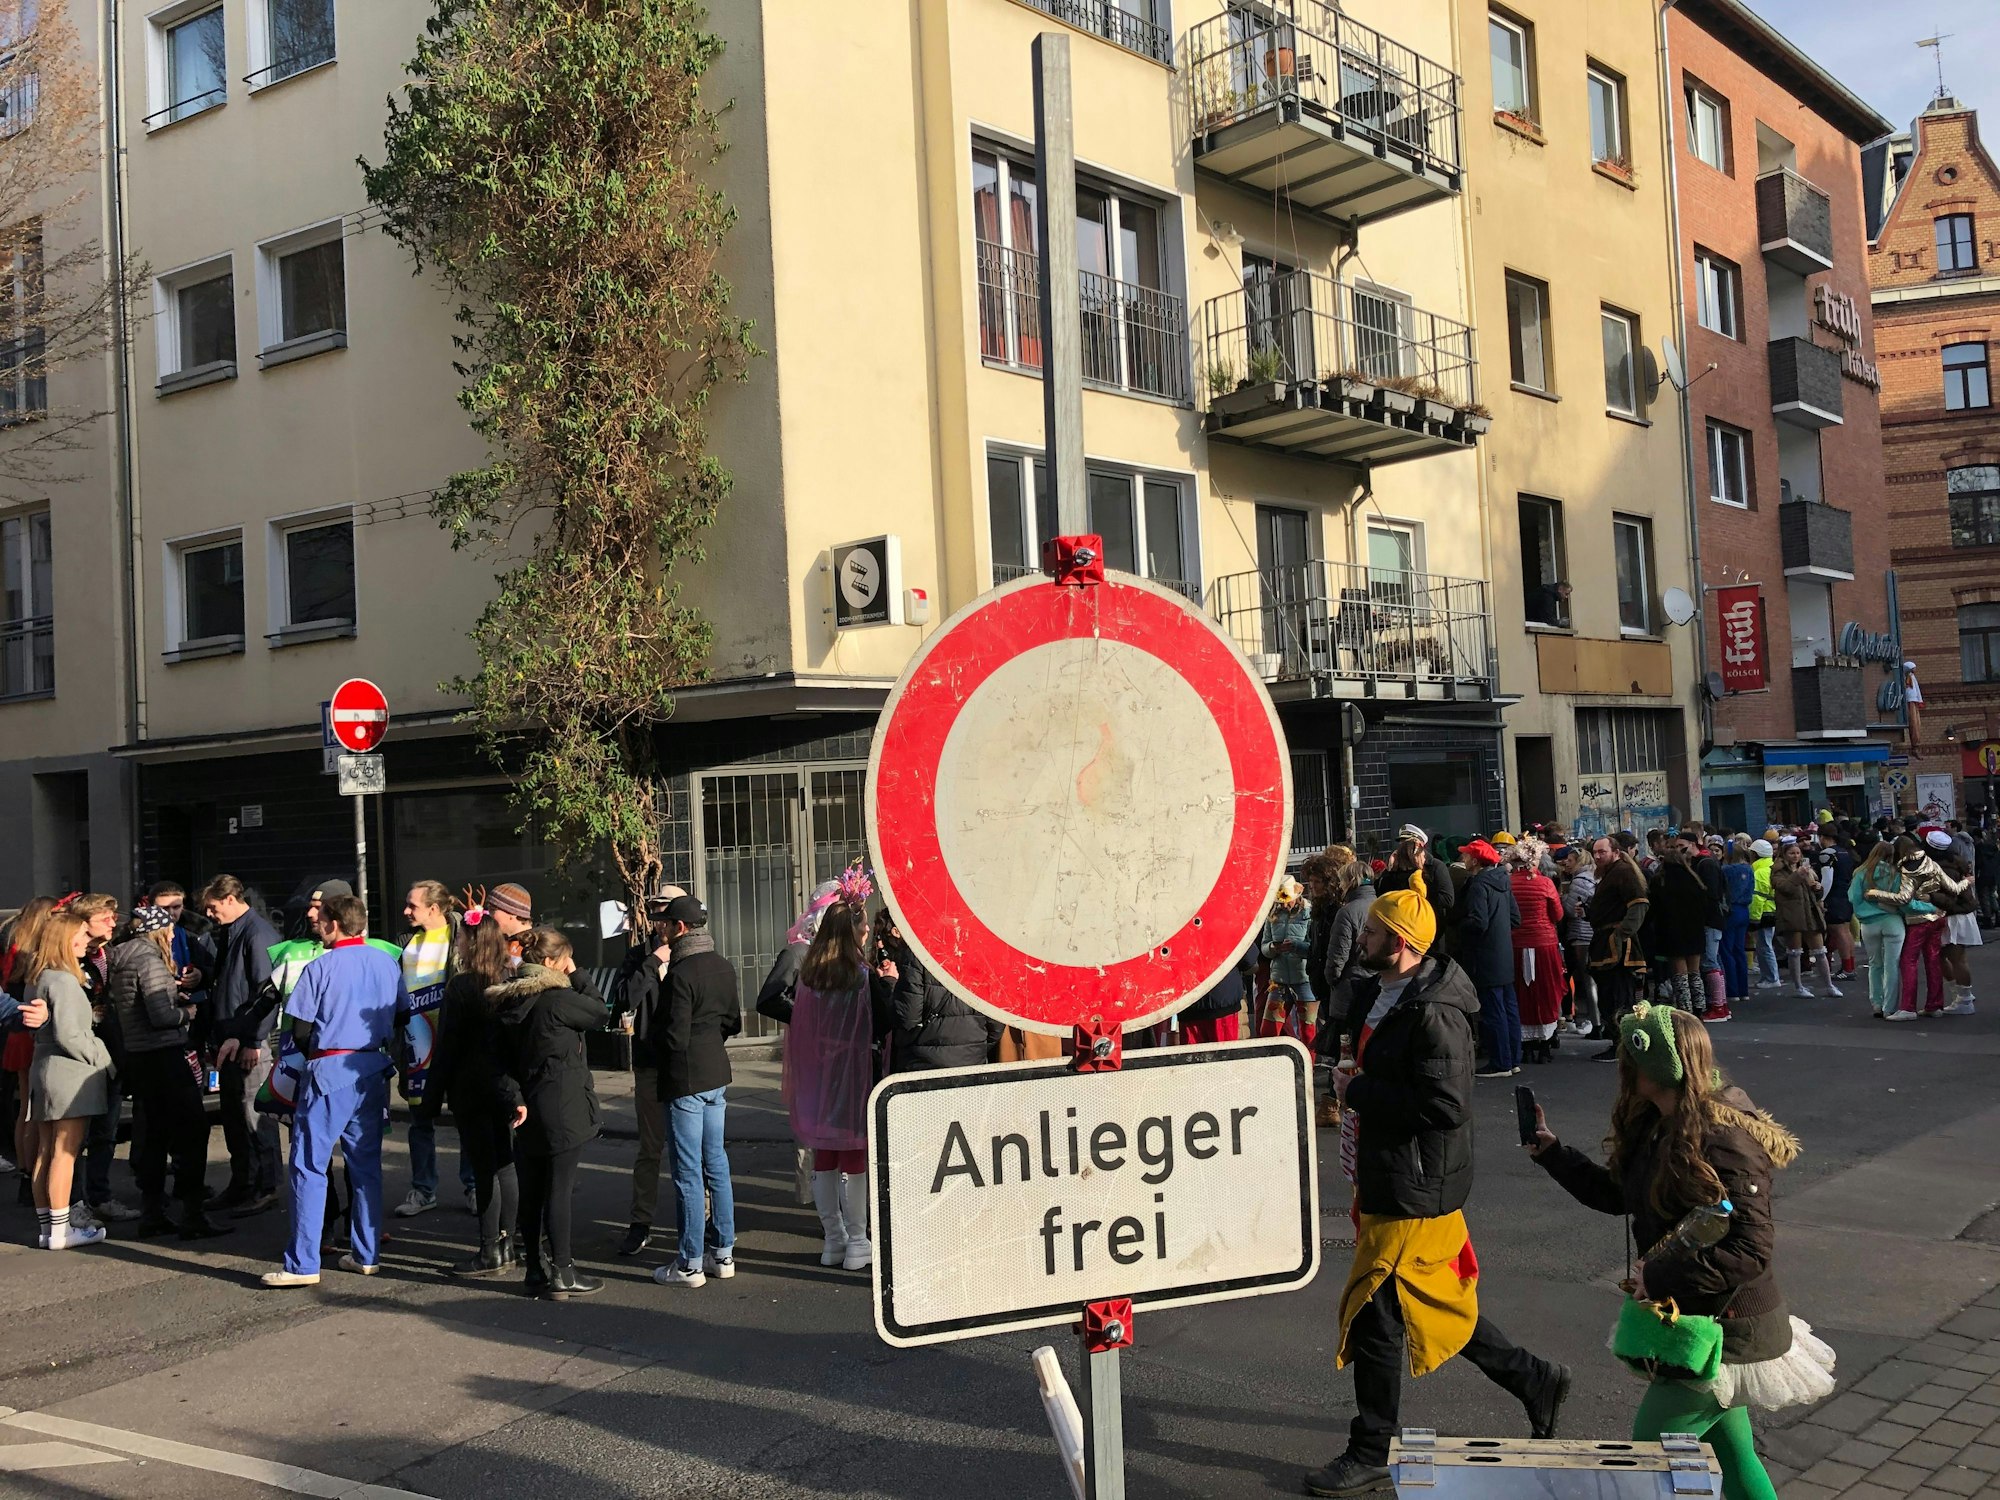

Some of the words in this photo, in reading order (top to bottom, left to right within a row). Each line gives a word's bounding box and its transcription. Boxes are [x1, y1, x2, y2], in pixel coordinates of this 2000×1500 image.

[1726, 668, 1760, 678] KÖLSCH
[1559, 783, 1568, 794] 23
[229, 817, 238, 834] 2
[930, 1105, 1258, 1194] Anlieger
[1039, 1193, 1167, 1276] frei
